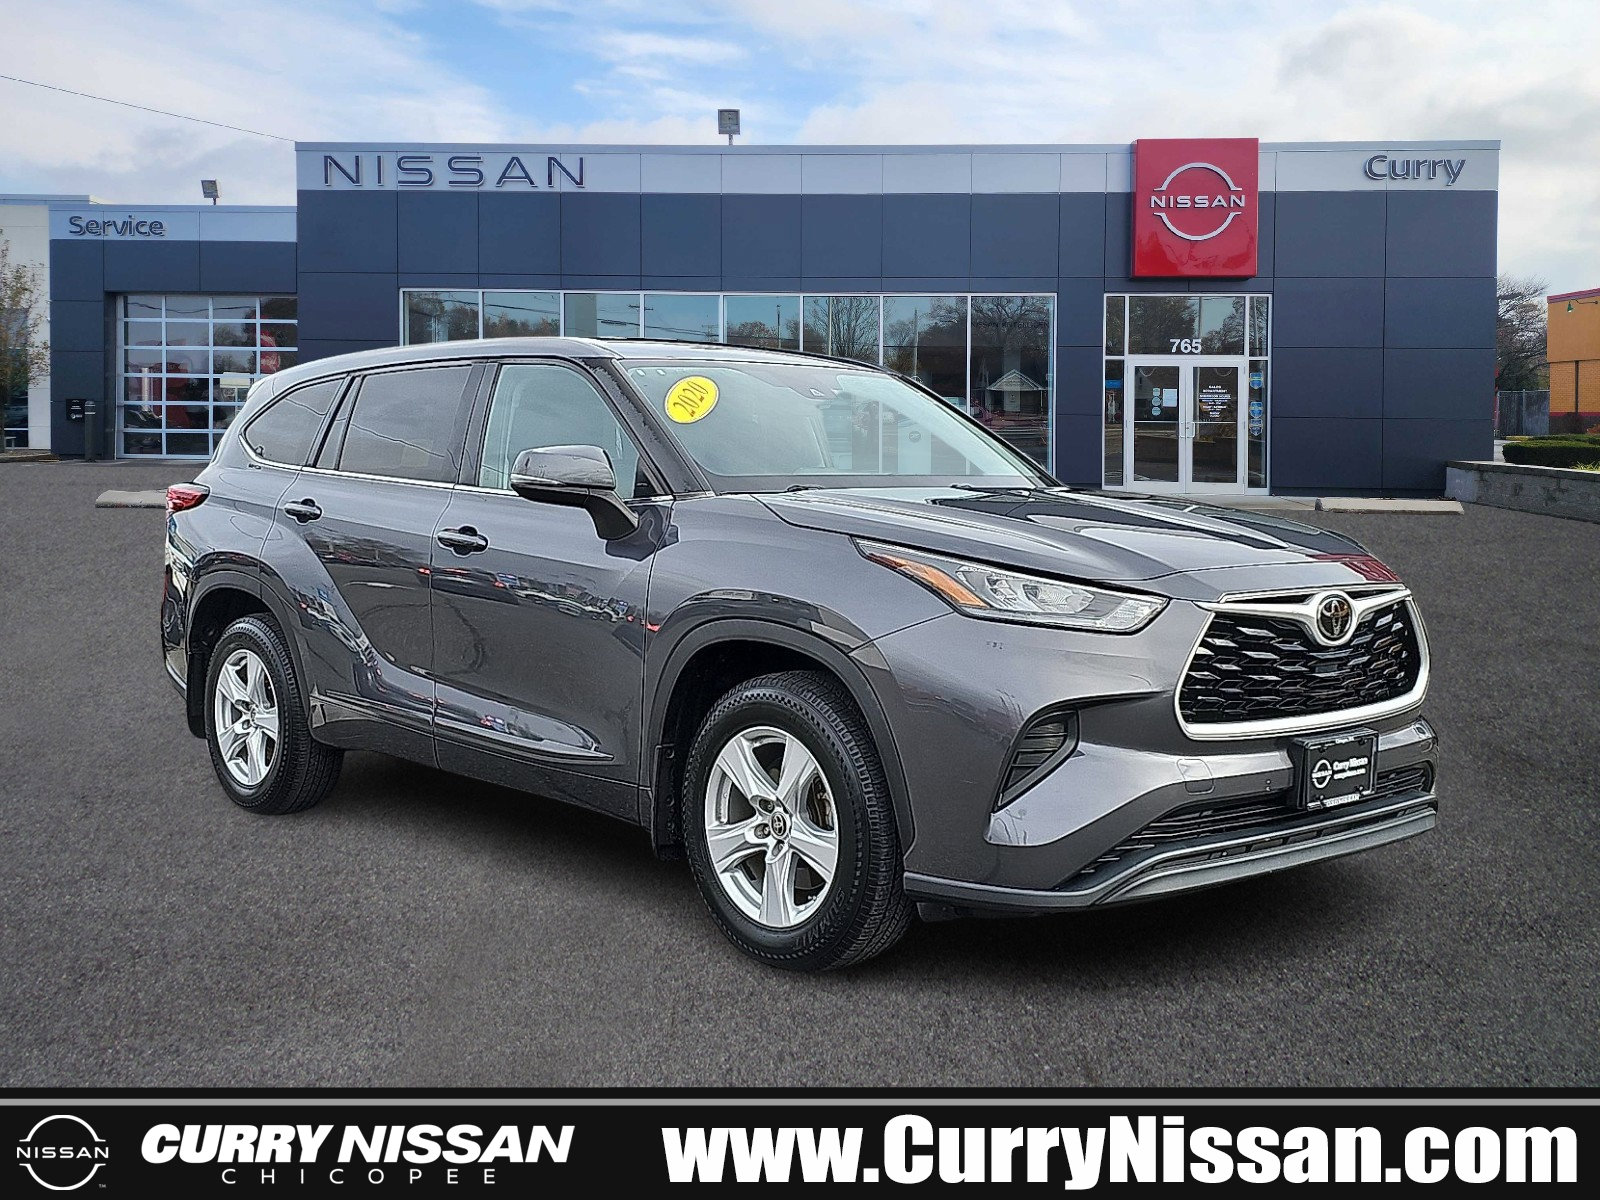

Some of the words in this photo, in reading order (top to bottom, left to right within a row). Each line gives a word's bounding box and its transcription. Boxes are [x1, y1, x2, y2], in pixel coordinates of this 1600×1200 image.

[323, 155, 585, 188] NISSAN
[1364, 154, 1466, 186] Curry
[1150, 194, 1246, 209] NISSAN
[69, 214, 165, 236] Service
[1169, 338, 1202, 354] 765
[672, 380, 709, 418] 2020
